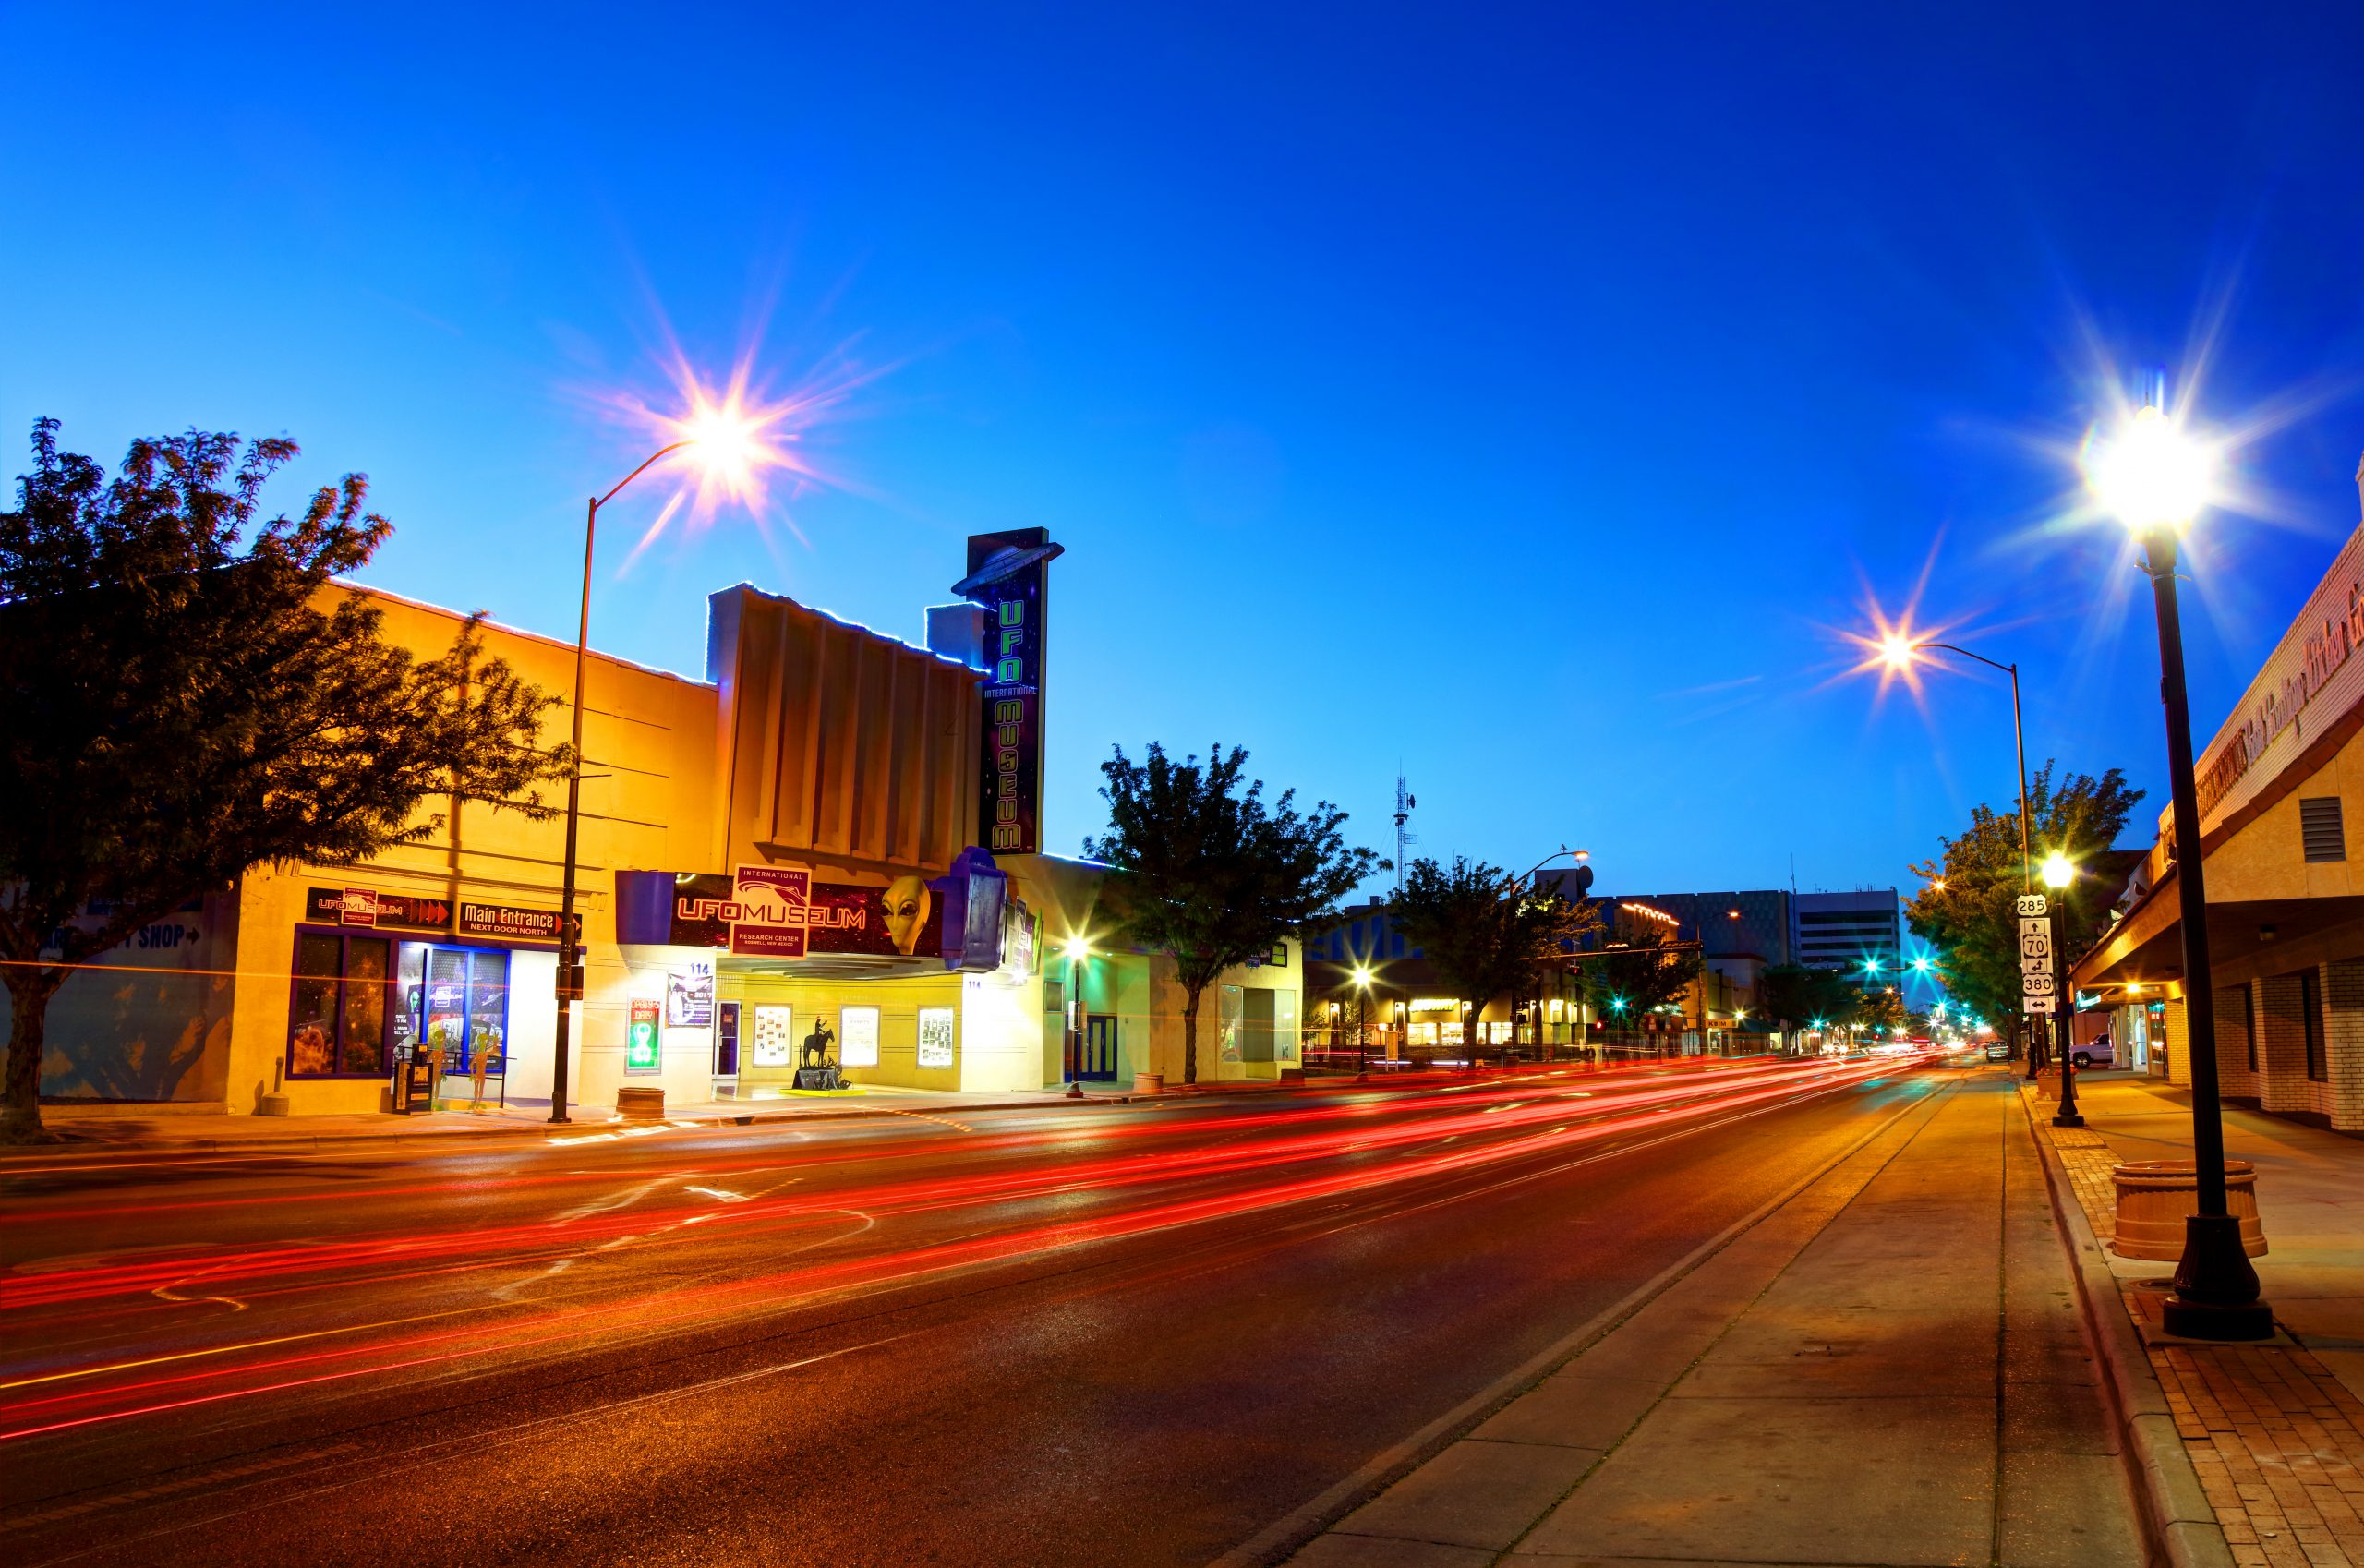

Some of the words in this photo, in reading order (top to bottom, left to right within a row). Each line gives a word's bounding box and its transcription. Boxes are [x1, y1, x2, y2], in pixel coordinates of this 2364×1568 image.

[999, 600, 1024, 685] UFO
[984, 686, 1036, 698] INTERNATIONAL
[992, 699, 1024, 850] MUSEUM
[743, 870, 803, 880] INTERNATIONAL
[2019, 899, 2044, 911] 285
[464, 905, 496, 923] Main
[501, 908, 554, 928] Entrance
[470, 923, 492, 932] NEXT
[494, 925, 518, 934] DOOR
[519, 927, 548, 935] NORTH
[139, 924, 184, 948] SHOP
[2027, 940, 2044, 953] 70
[691, 963, 709, 975] 114
[2025, 979, 2051, 990] 380
